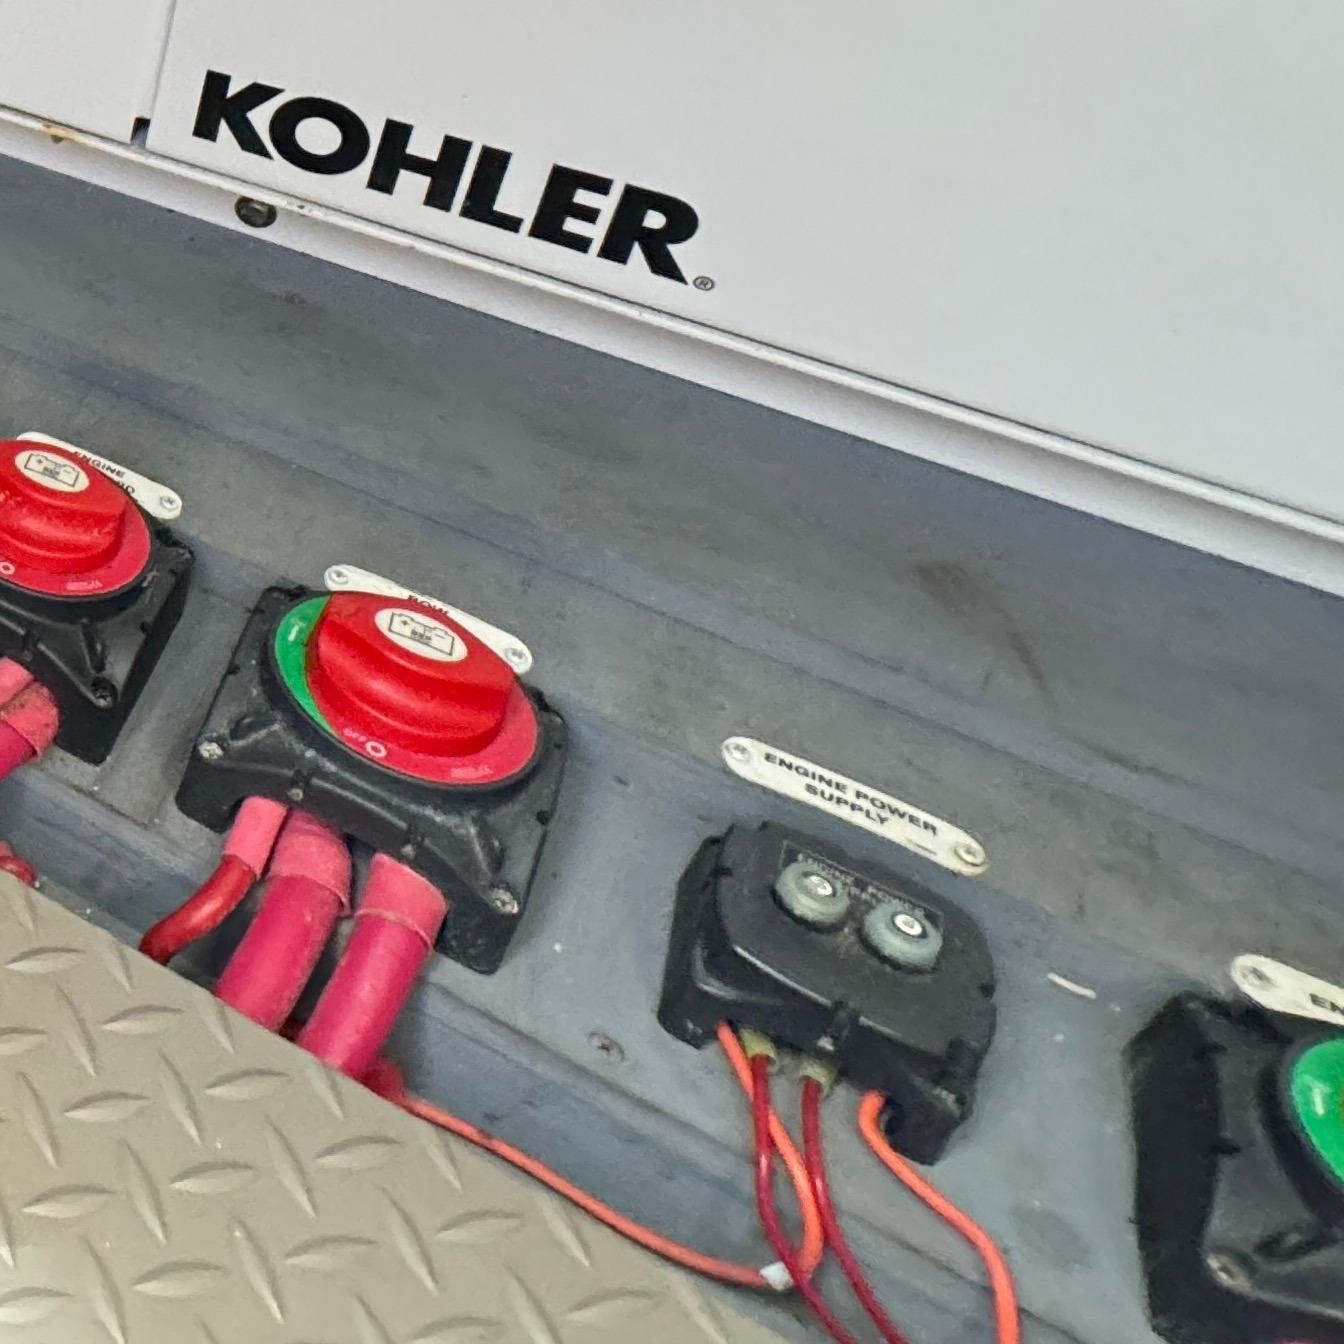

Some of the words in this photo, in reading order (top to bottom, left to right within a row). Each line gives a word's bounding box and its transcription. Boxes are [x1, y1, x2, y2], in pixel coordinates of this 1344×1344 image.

[192, 68, 699, 286] KOHLER
[764, 752, 849, 795] ENGINE
[855, 790, 939, 836] POWER
[805, 783, 889, 825] SUPPLY
